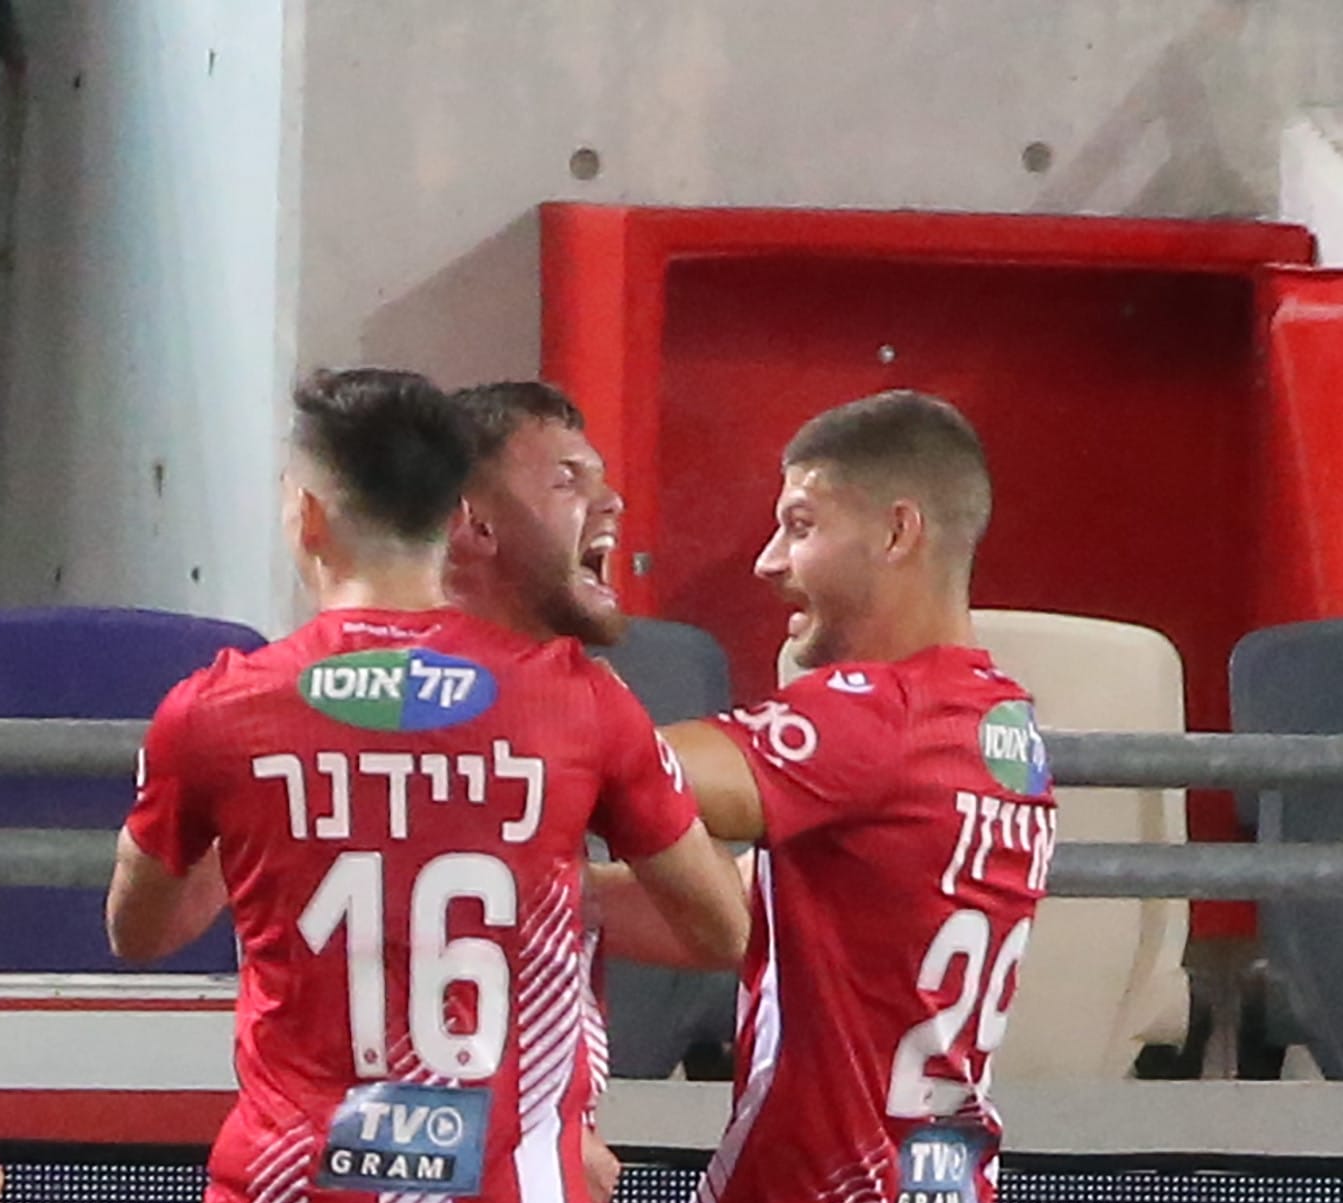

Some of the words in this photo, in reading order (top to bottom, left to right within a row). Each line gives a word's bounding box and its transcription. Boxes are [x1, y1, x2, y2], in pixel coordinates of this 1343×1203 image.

[309, 665, 404, 700] אוטו
[410, 659, 478, 708] קל
[253, 740, 546, 843] ליידנר
[297, 851, 518, 1080] 16
[330, 1148, 446, 1180] GRAM
